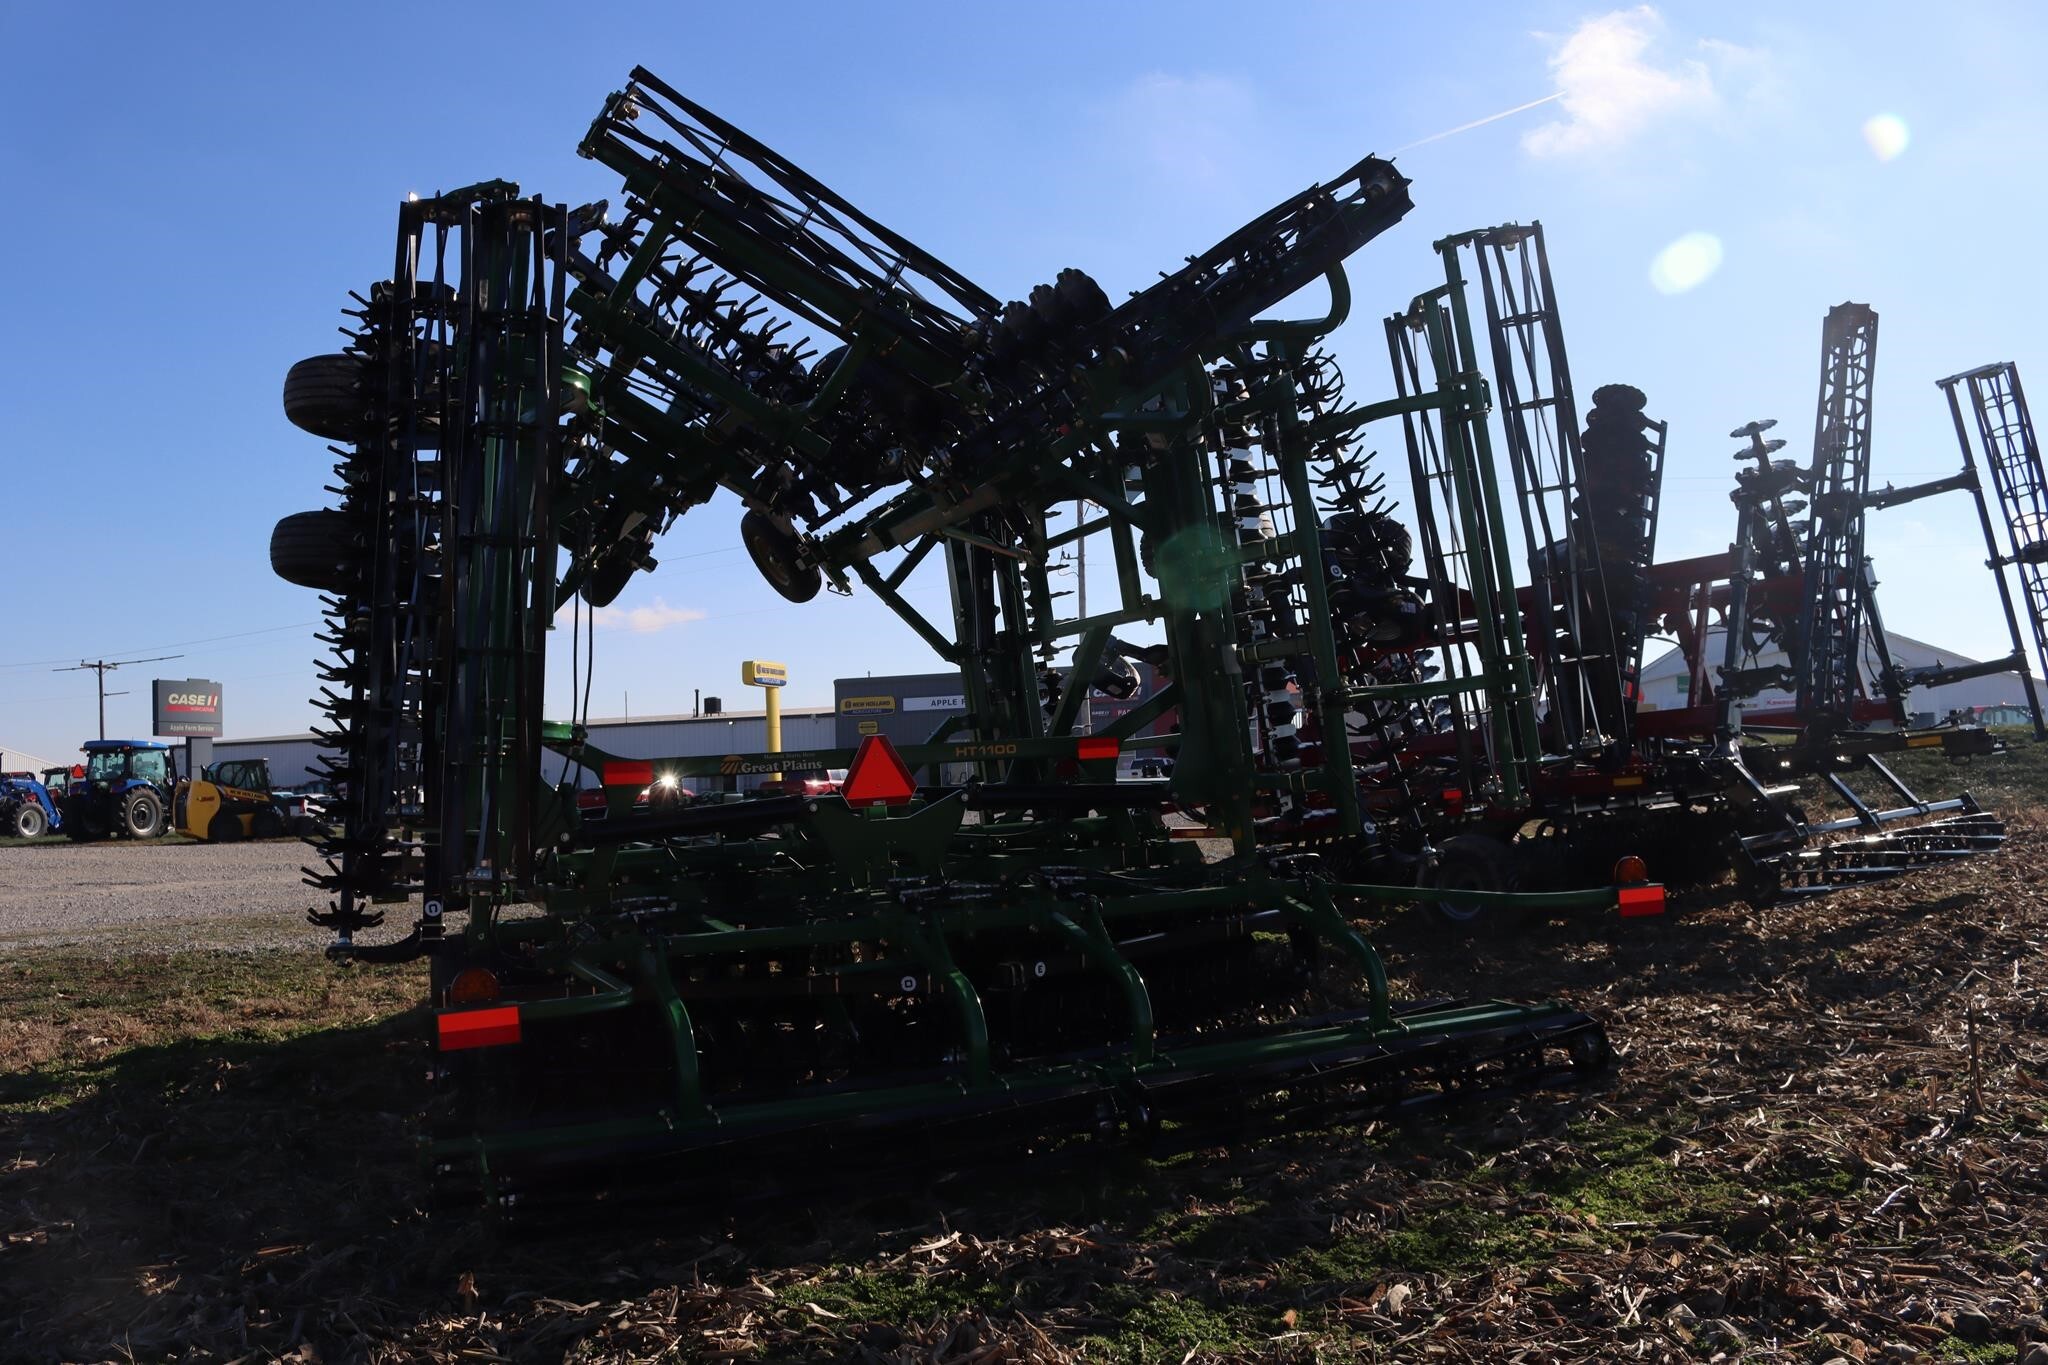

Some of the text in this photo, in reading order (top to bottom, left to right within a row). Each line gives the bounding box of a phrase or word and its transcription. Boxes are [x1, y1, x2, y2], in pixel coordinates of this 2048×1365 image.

[168, 693, 206, 706] CASE
[955, 744, 1017, 757] HT1100
[740, 759, 823, 774] Great Plains
